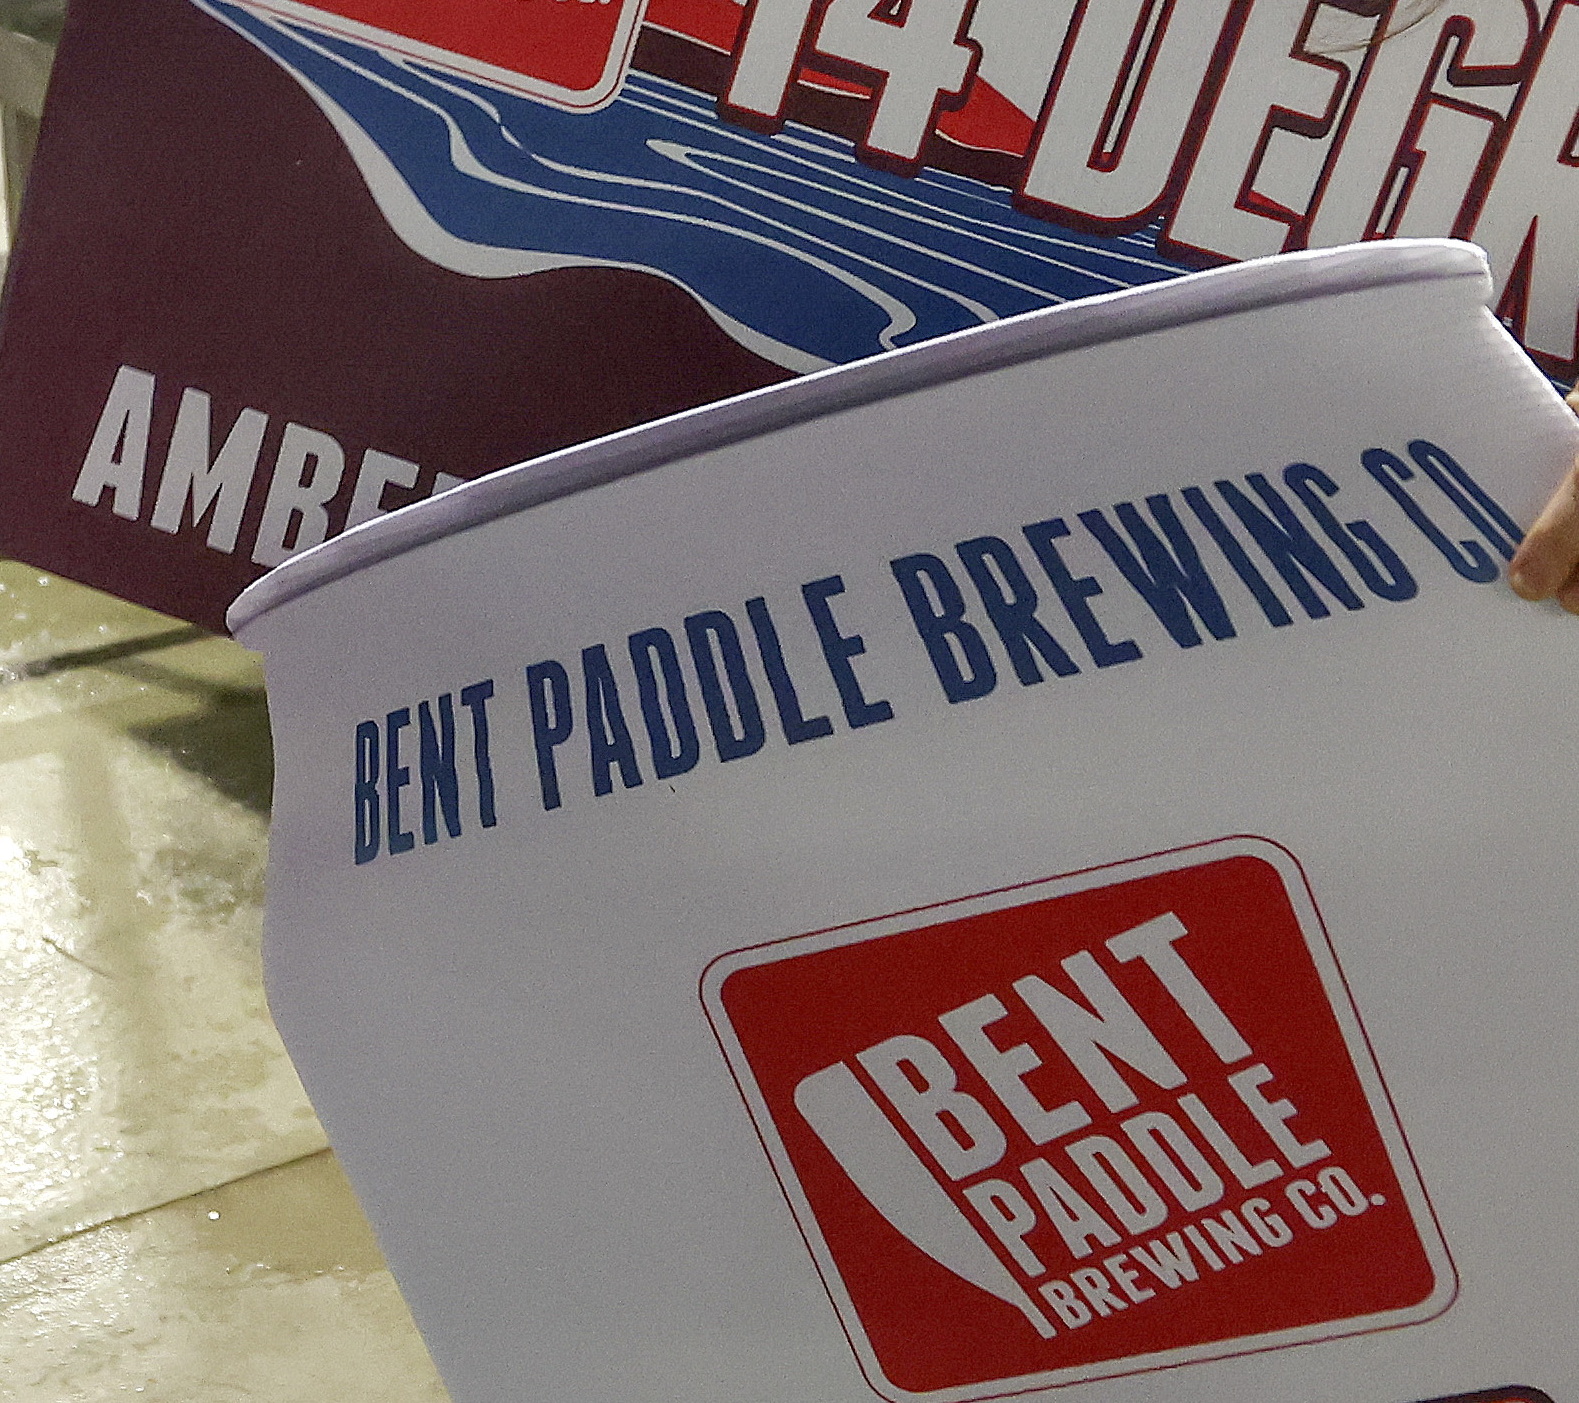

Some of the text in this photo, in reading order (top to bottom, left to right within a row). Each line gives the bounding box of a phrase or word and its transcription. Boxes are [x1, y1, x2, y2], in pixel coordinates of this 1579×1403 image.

[71, 363, 466, 568] AMBE
[353, 680, 497, 865] BENT
[525, 576, 895, 810] PADDLE
[889, 460, 1421, 706] BREWING
[854, 910, 1253, 1182] BENT
[962, 1061, 1332, 1278] PADDLE
[1038, 1164, 1386, 1331] BREWING CO.
